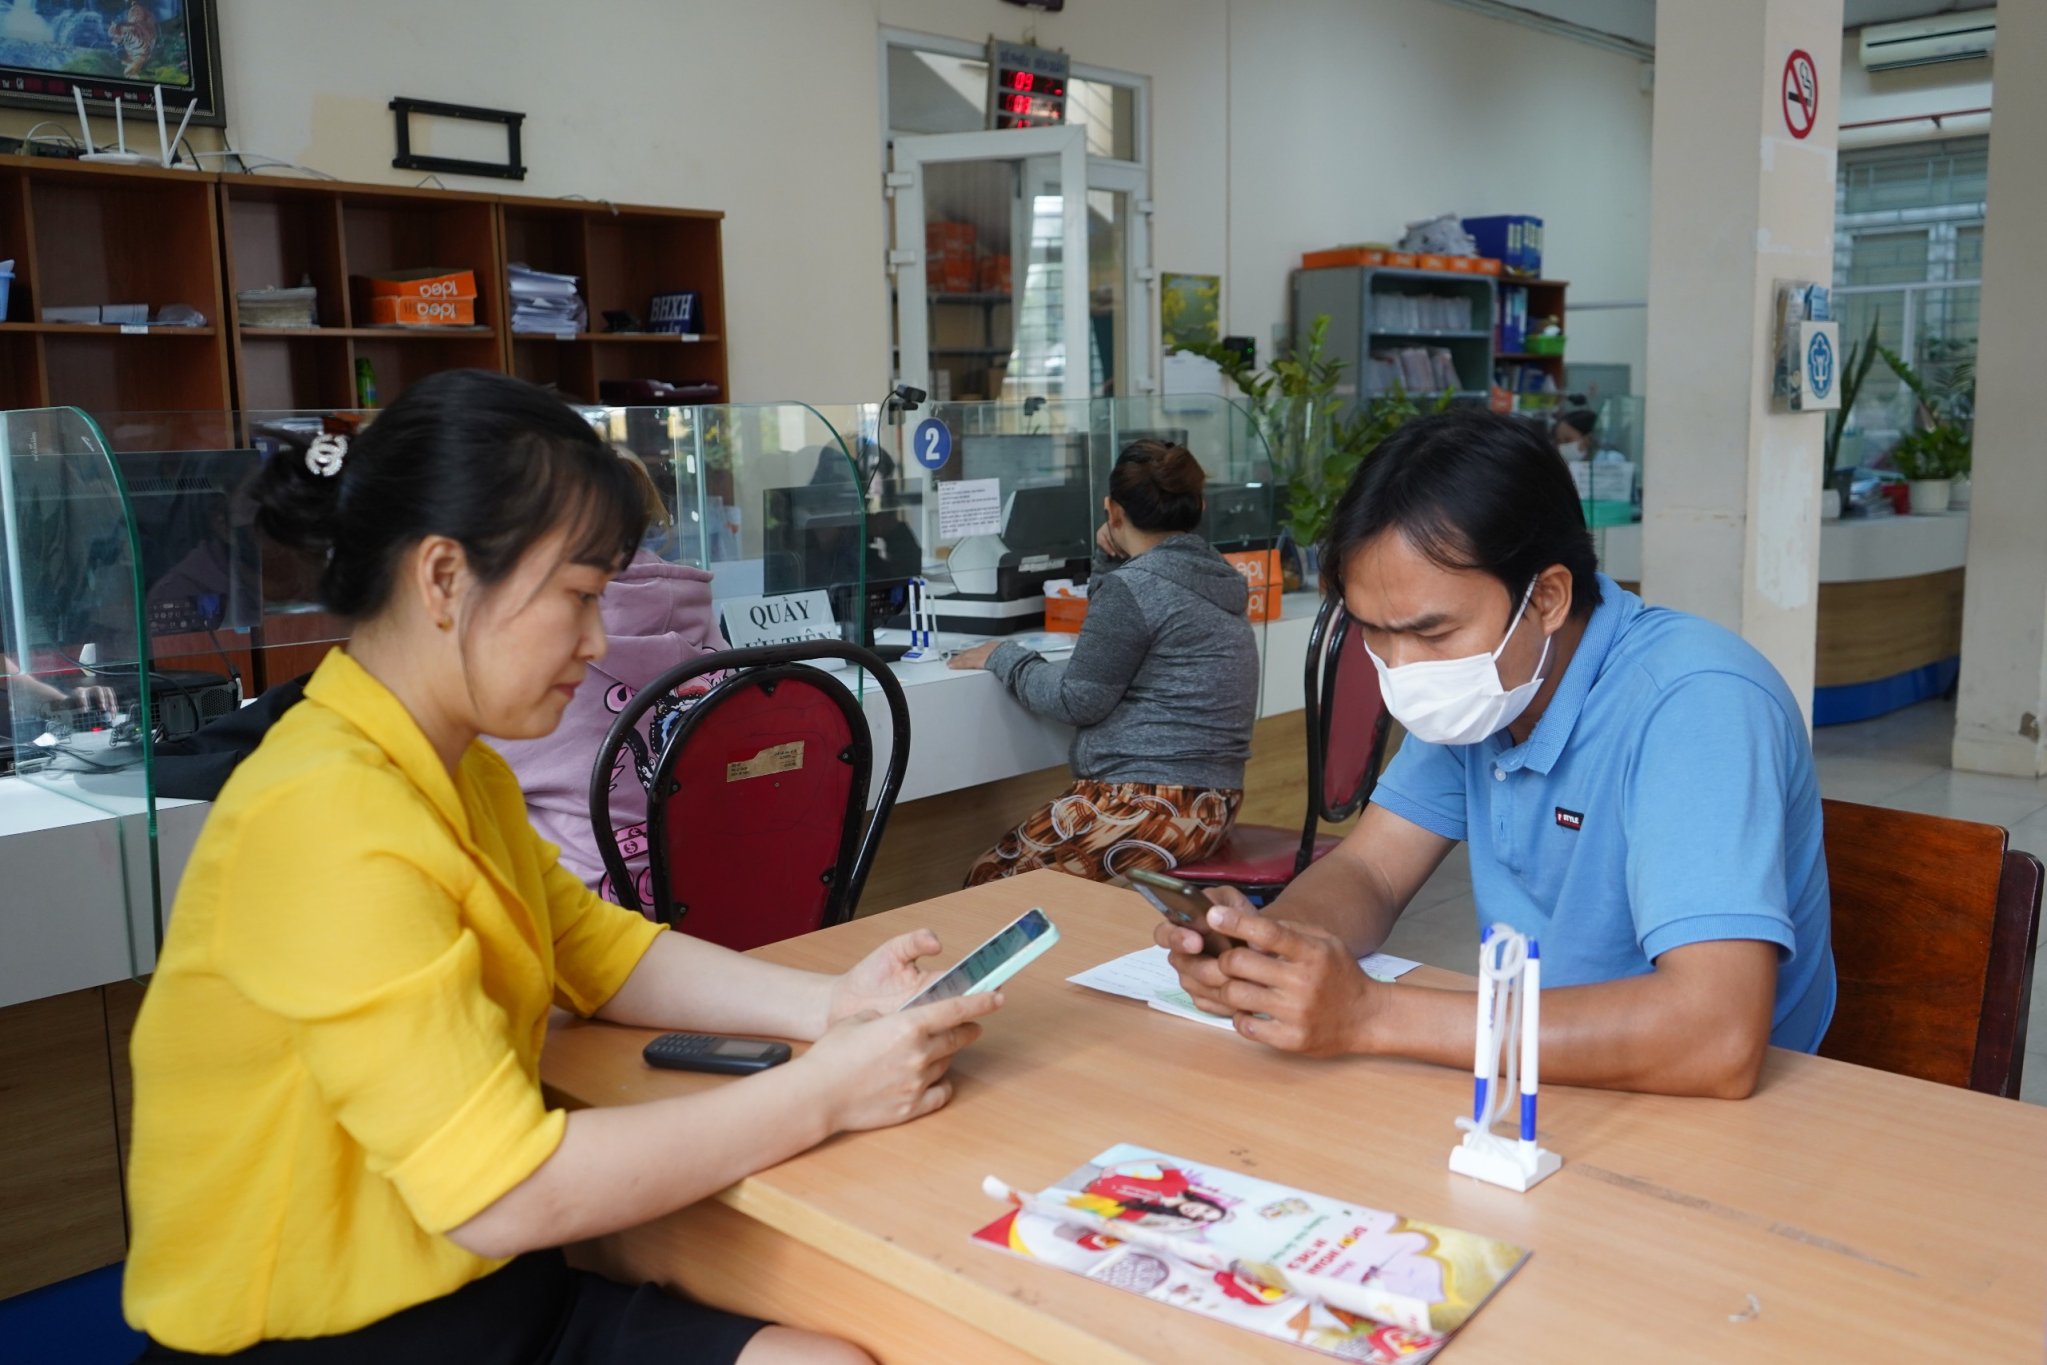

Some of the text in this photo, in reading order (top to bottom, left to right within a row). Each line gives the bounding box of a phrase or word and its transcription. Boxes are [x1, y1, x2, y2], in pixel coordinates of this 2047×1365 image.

[418, 280, 458, 301] idea
[416, 302, 457, 320] idea
[650, 293, 693, 322] BHXH
[925, 427, 940, 461] 2
[749, 596, 810, 630] QUẦY
